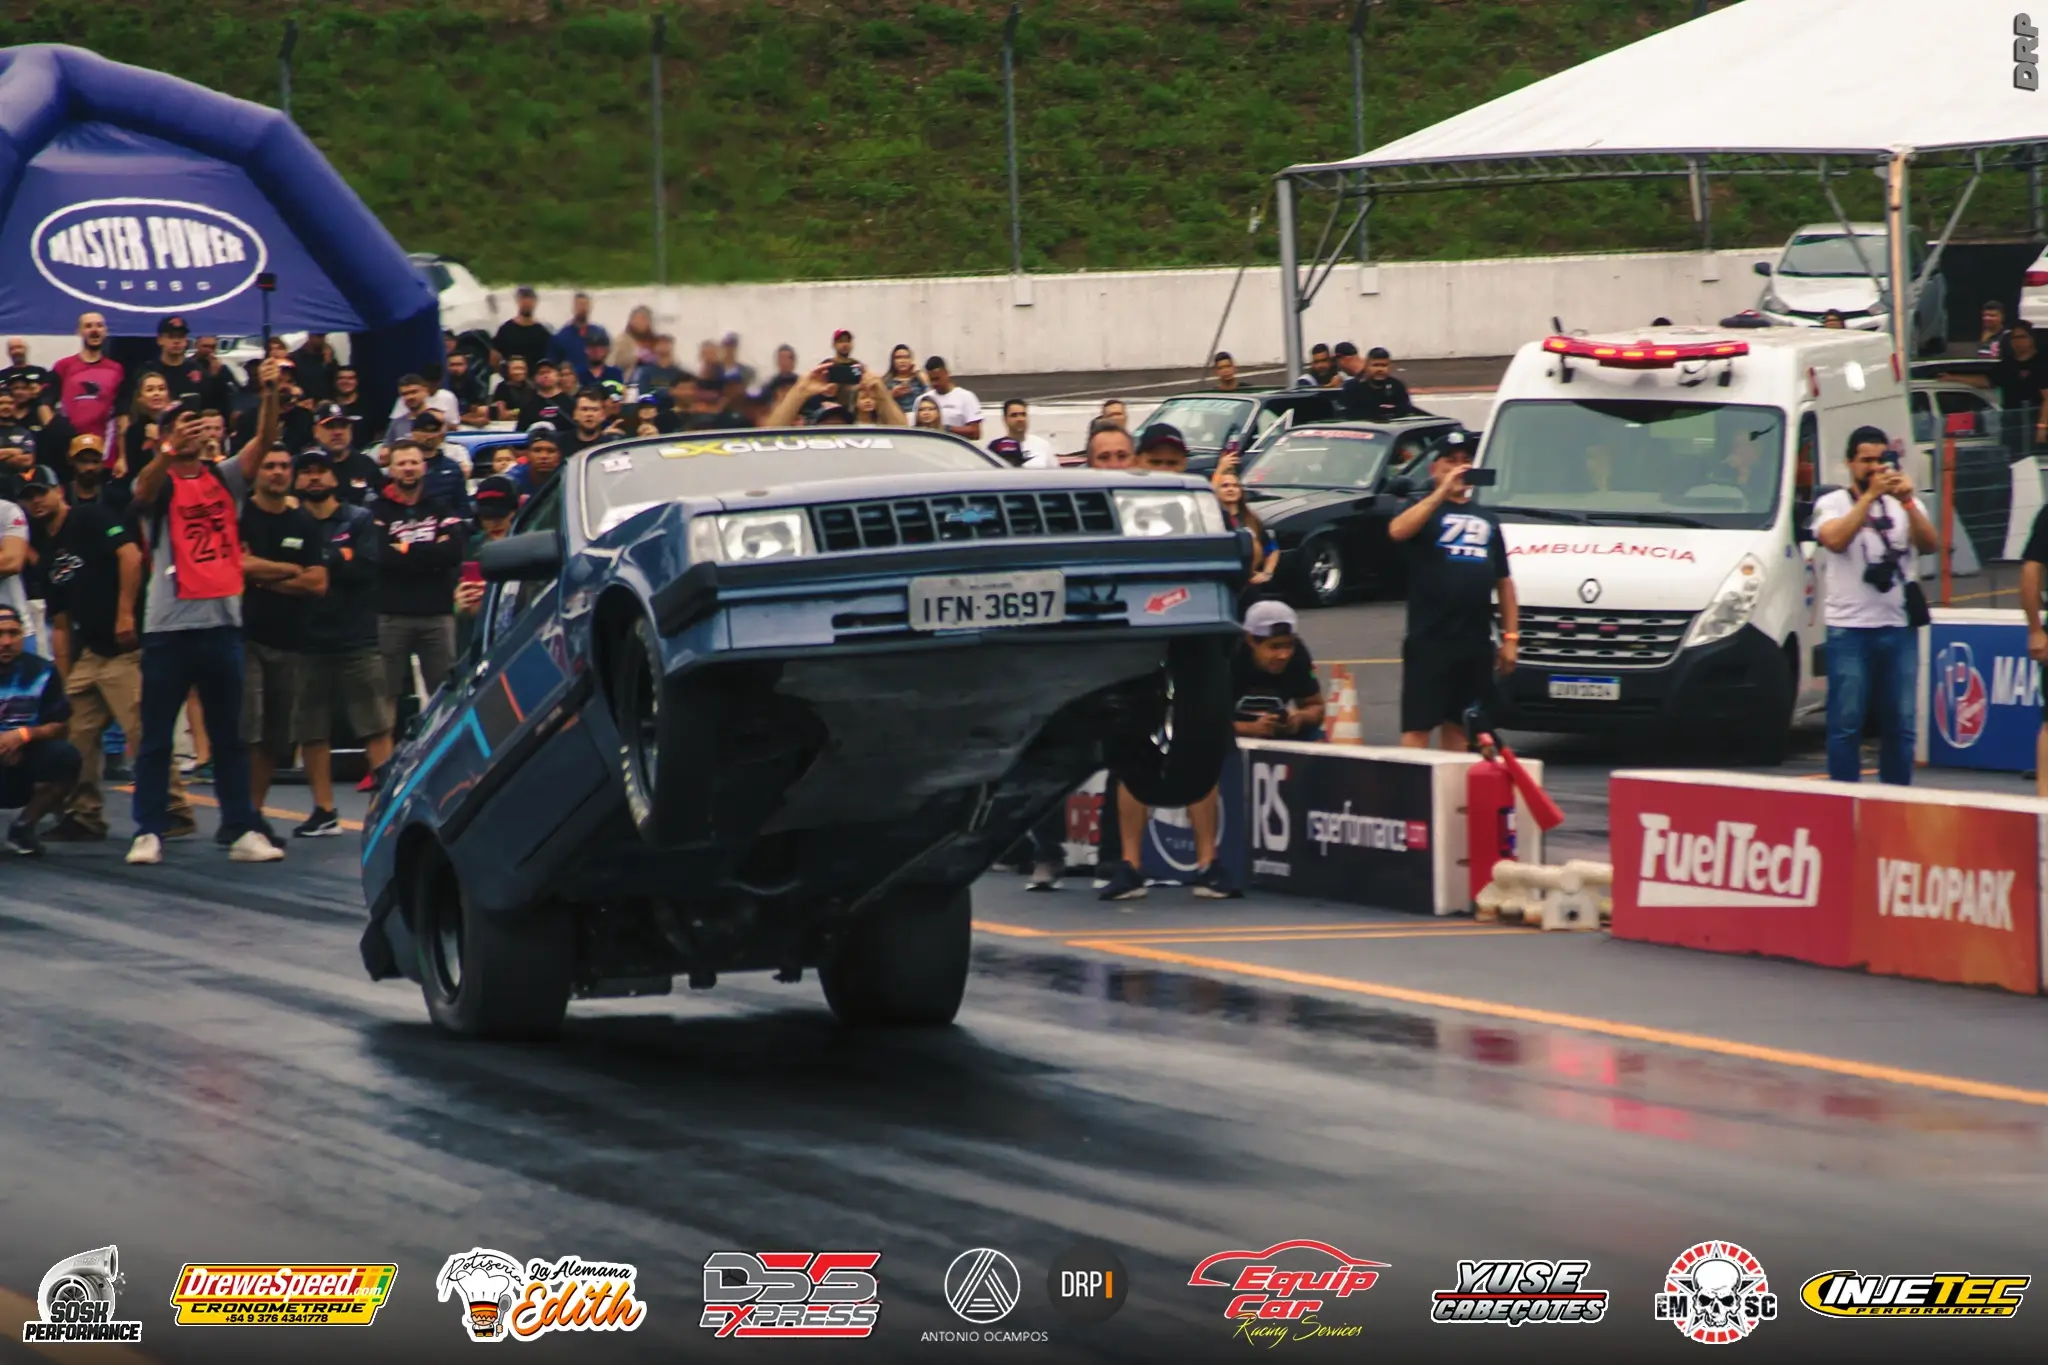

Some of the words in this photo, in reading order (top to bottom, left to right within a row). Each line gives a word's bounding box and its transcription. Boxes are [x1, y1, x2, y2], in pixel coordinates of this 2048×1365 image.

[48, 217, 149, 270] MASTER
[146, 216, 246, 269] POWER
[1439, 514, 1491, 546] 79
[1507, 542, 1696, 563] AMBULÂNCIA
[1253, 762, 1291, 852] RS
[1638, 812, 1822, 900] FuelTech
[1877, 857, 2015, 931] VELOPARK
